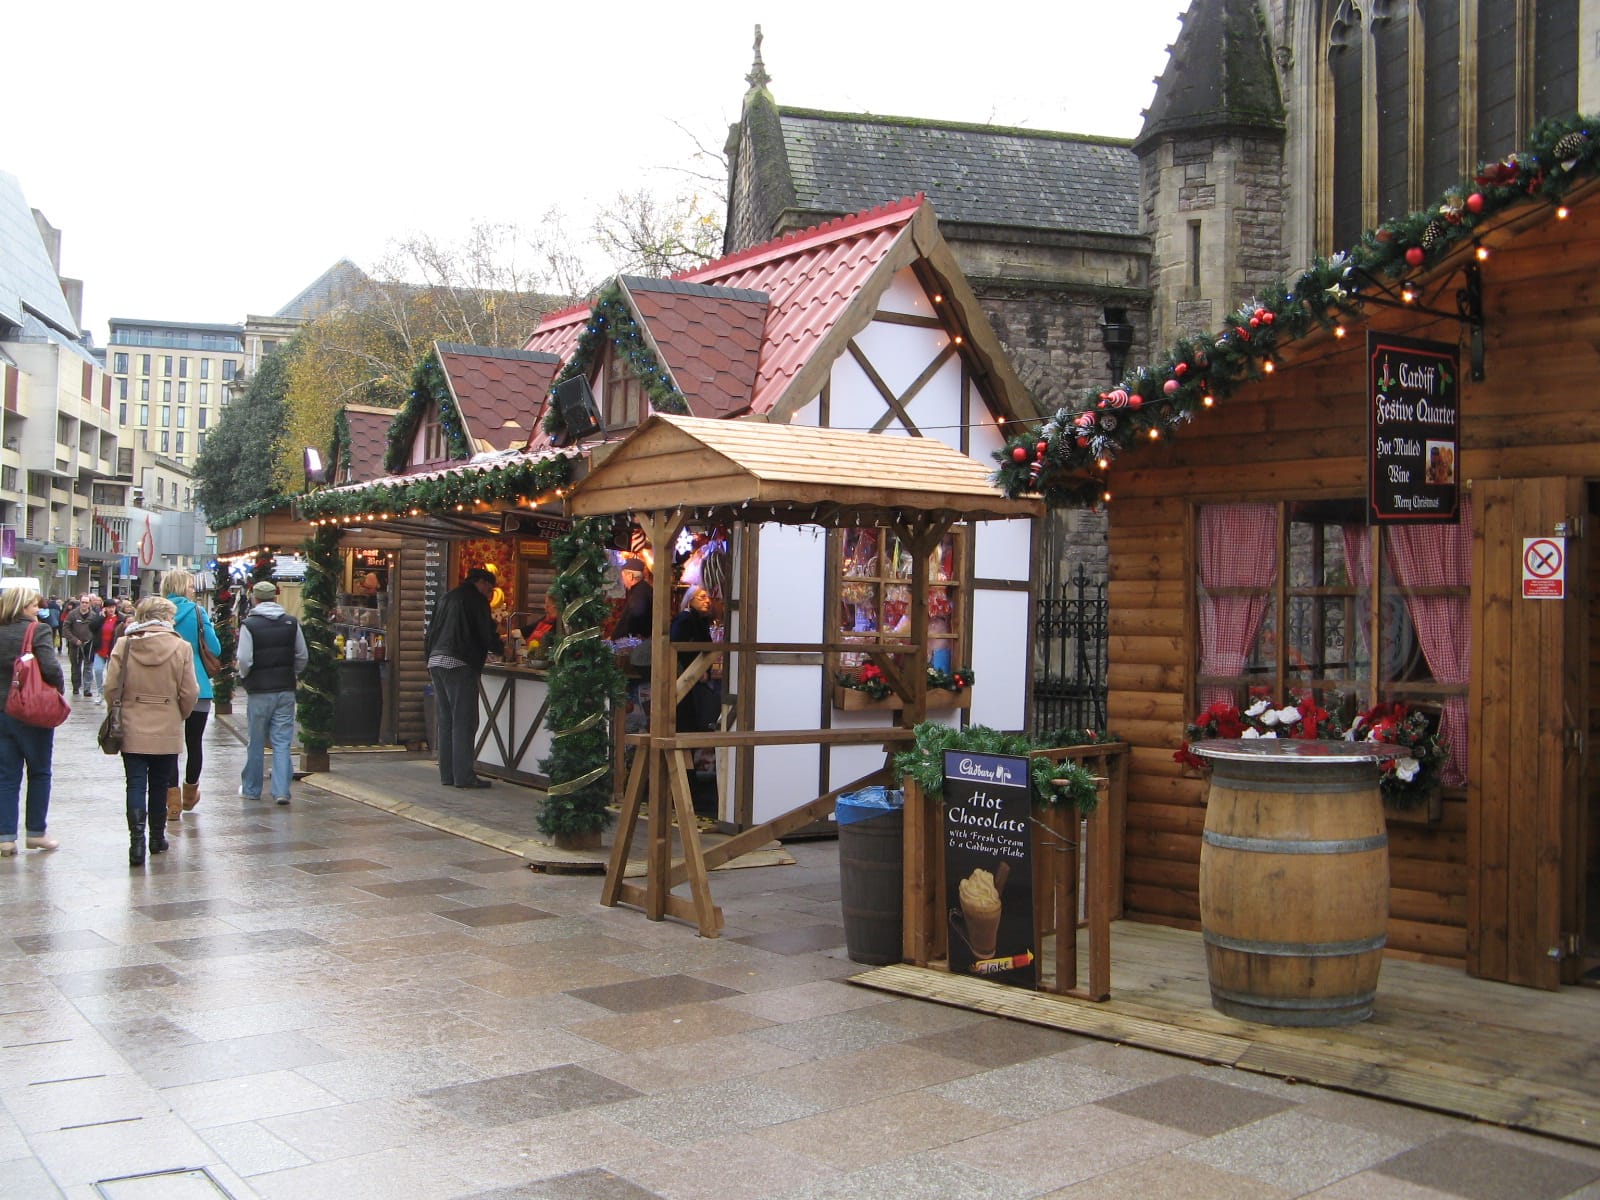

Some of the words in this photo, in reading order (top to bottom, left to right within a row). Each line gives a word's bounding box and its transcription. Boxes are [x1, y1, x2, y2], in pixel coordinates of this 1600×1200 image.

[1399, 362, 1435, 395] Cardiff
[1376, 394, 1414, 425] Festive
[1416, 398, 1456, 425] Quarter
[1376, 437, 1392, 458] Hot
[1393, 437, 1421, 457] Mulled
[1387, 464, 1410, 483] Wine
[1393, 494, 1412, 511] Merry
[1412, 495, 1439, 509] Christmas
[959, 758, 995, 781] Cadbury
[967, 791, 1003, 810] Hot
[948, 807, 1025, 832] Chocolate
[949, 829, 968, 839] with
[970, 831, 995, 843] Fresh
[997, 835, 1024, 847] Cream
[965, 840, 999, 856] Cadbury
[1000, 846, 1025, 858] Flake
